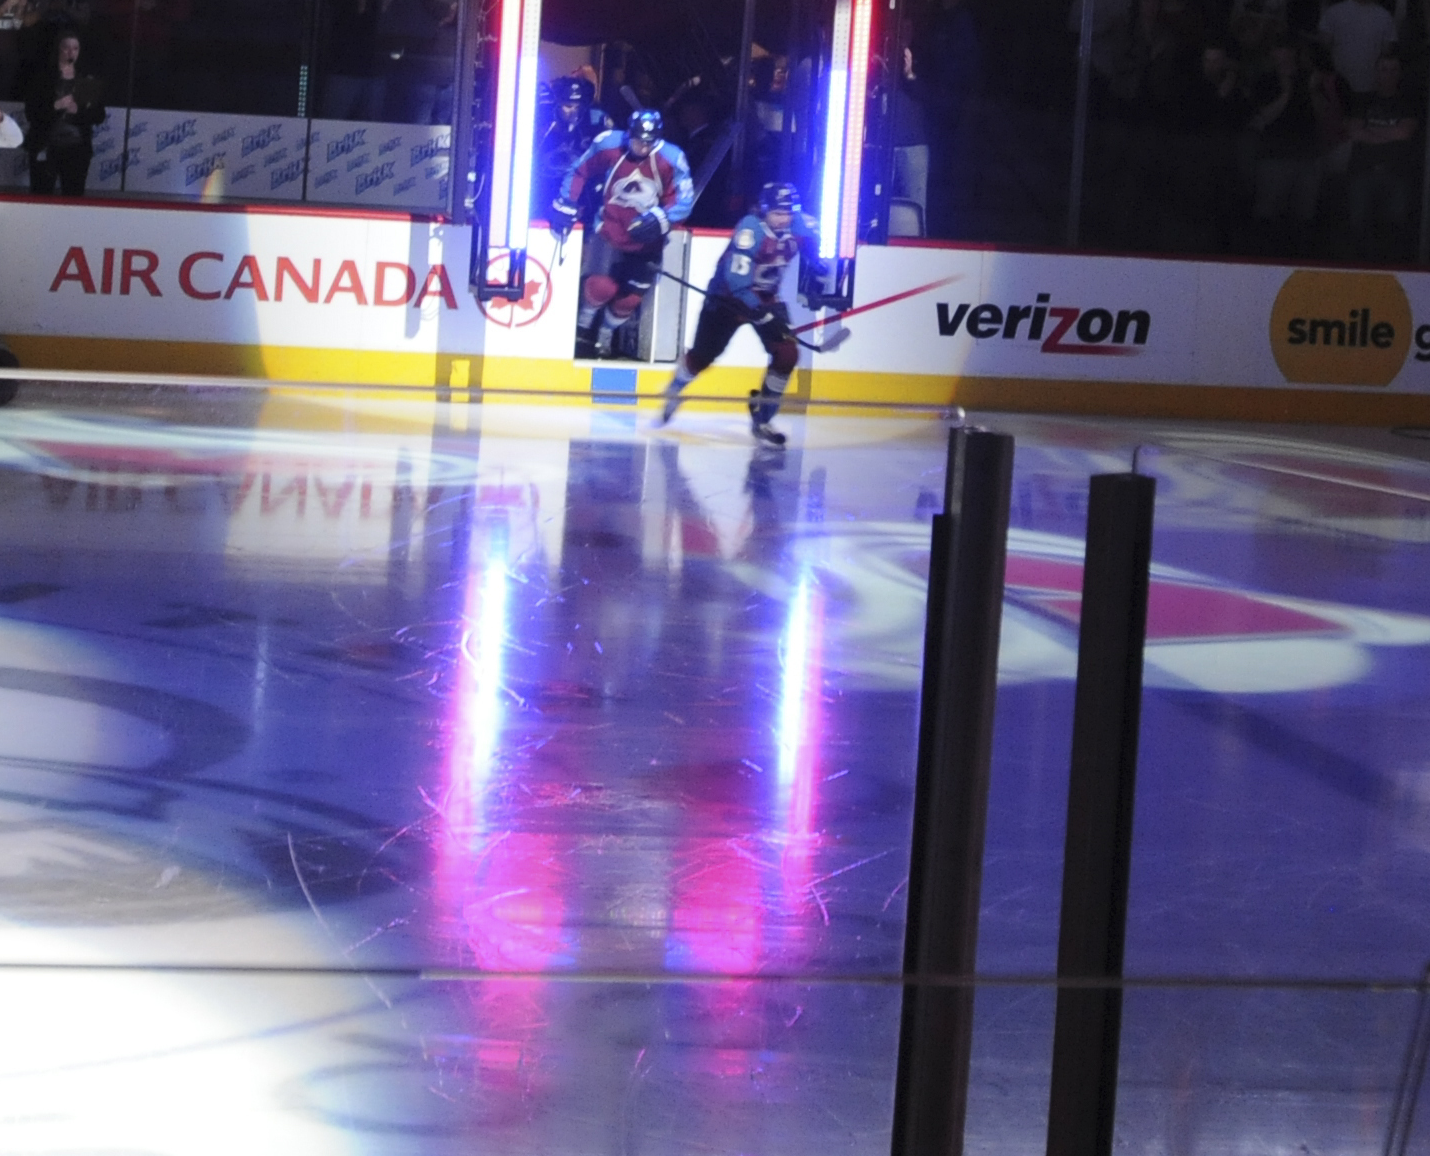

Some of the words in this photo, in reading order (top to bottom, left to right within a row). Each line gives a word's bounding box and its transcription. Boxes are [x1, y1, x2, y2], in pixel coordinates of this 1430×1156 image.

[48, 245, 162, 298] AIR
[178, 251, 459, 310] CANADA
[936, 293, 1151, 356] verizon
[1287, 307, 1395, 349] smile
